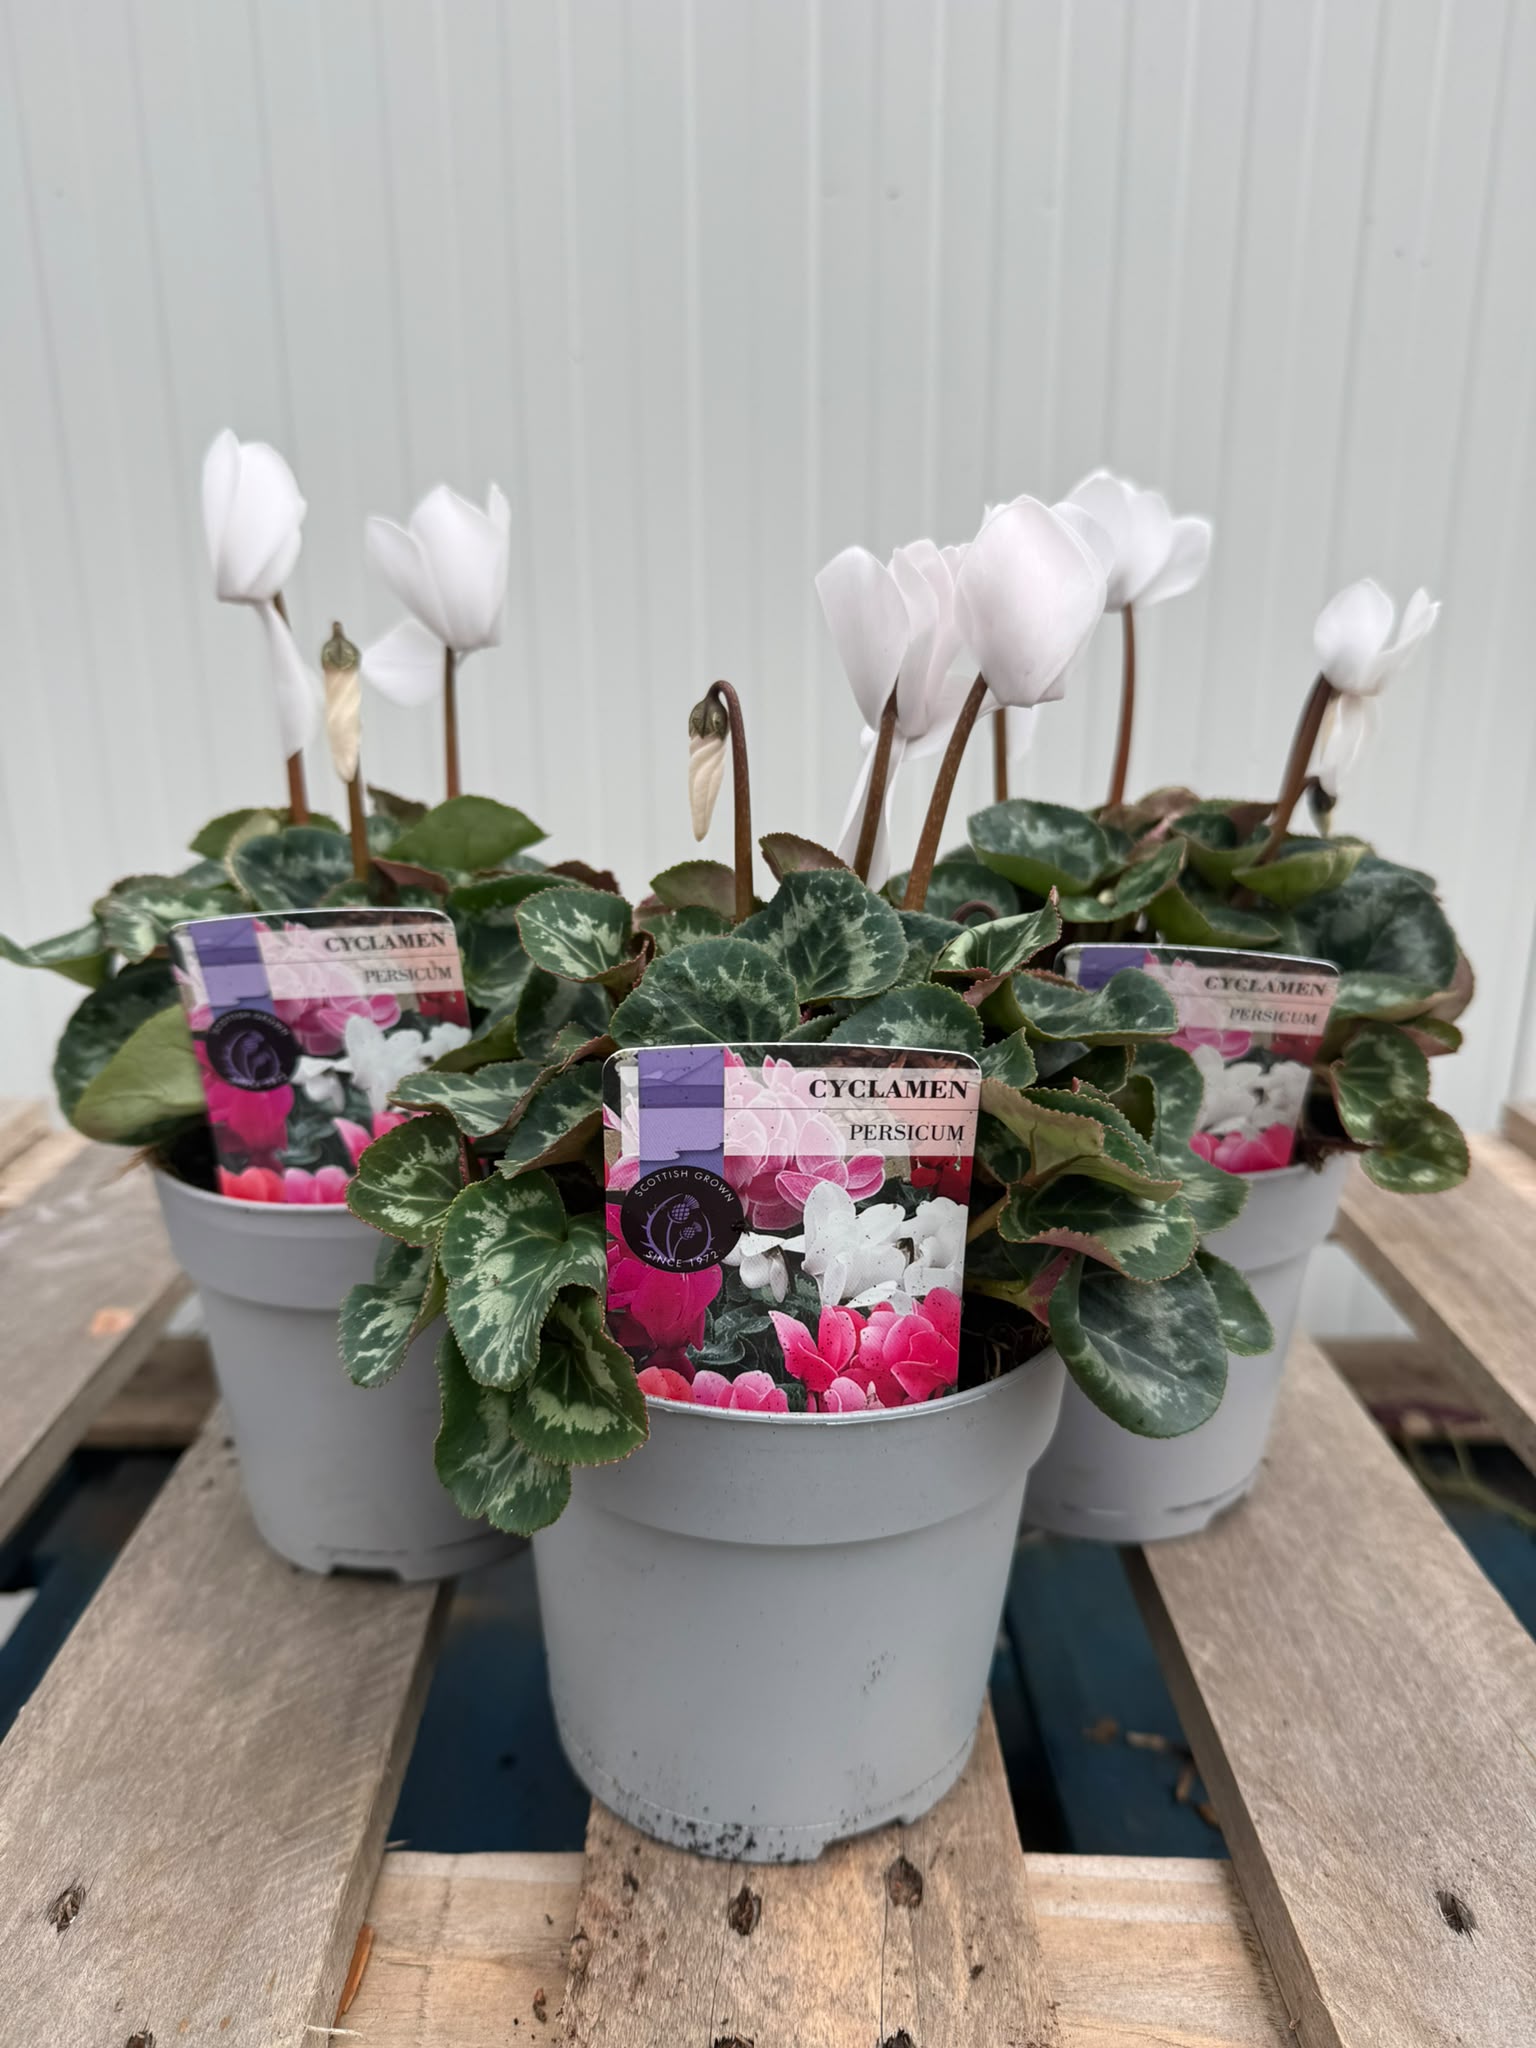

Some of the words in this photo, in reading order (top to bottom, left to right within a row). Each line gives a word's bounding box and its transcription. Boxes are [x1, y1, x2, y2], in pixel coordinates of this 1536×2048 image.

[324, 932, 447, 953] CYCLAMEN
[364, 966, 453, 984] PERSICUM
[1204, 976, 1327, 997] CYCLAMEN
[1229, 1007, 1317, 1026] PERSICUM
[809, 1079, 969, 1099] CYCLAMEN
[850, 1124, 965, 1142] PERSICUM
[634, 1170, 688, 1197] SCOTTISH
[695, 1171, 735, 1203] GROWN
[645, 1250, 682, 1268] SINCE
[689, 1251, 719, 1267] 1972
